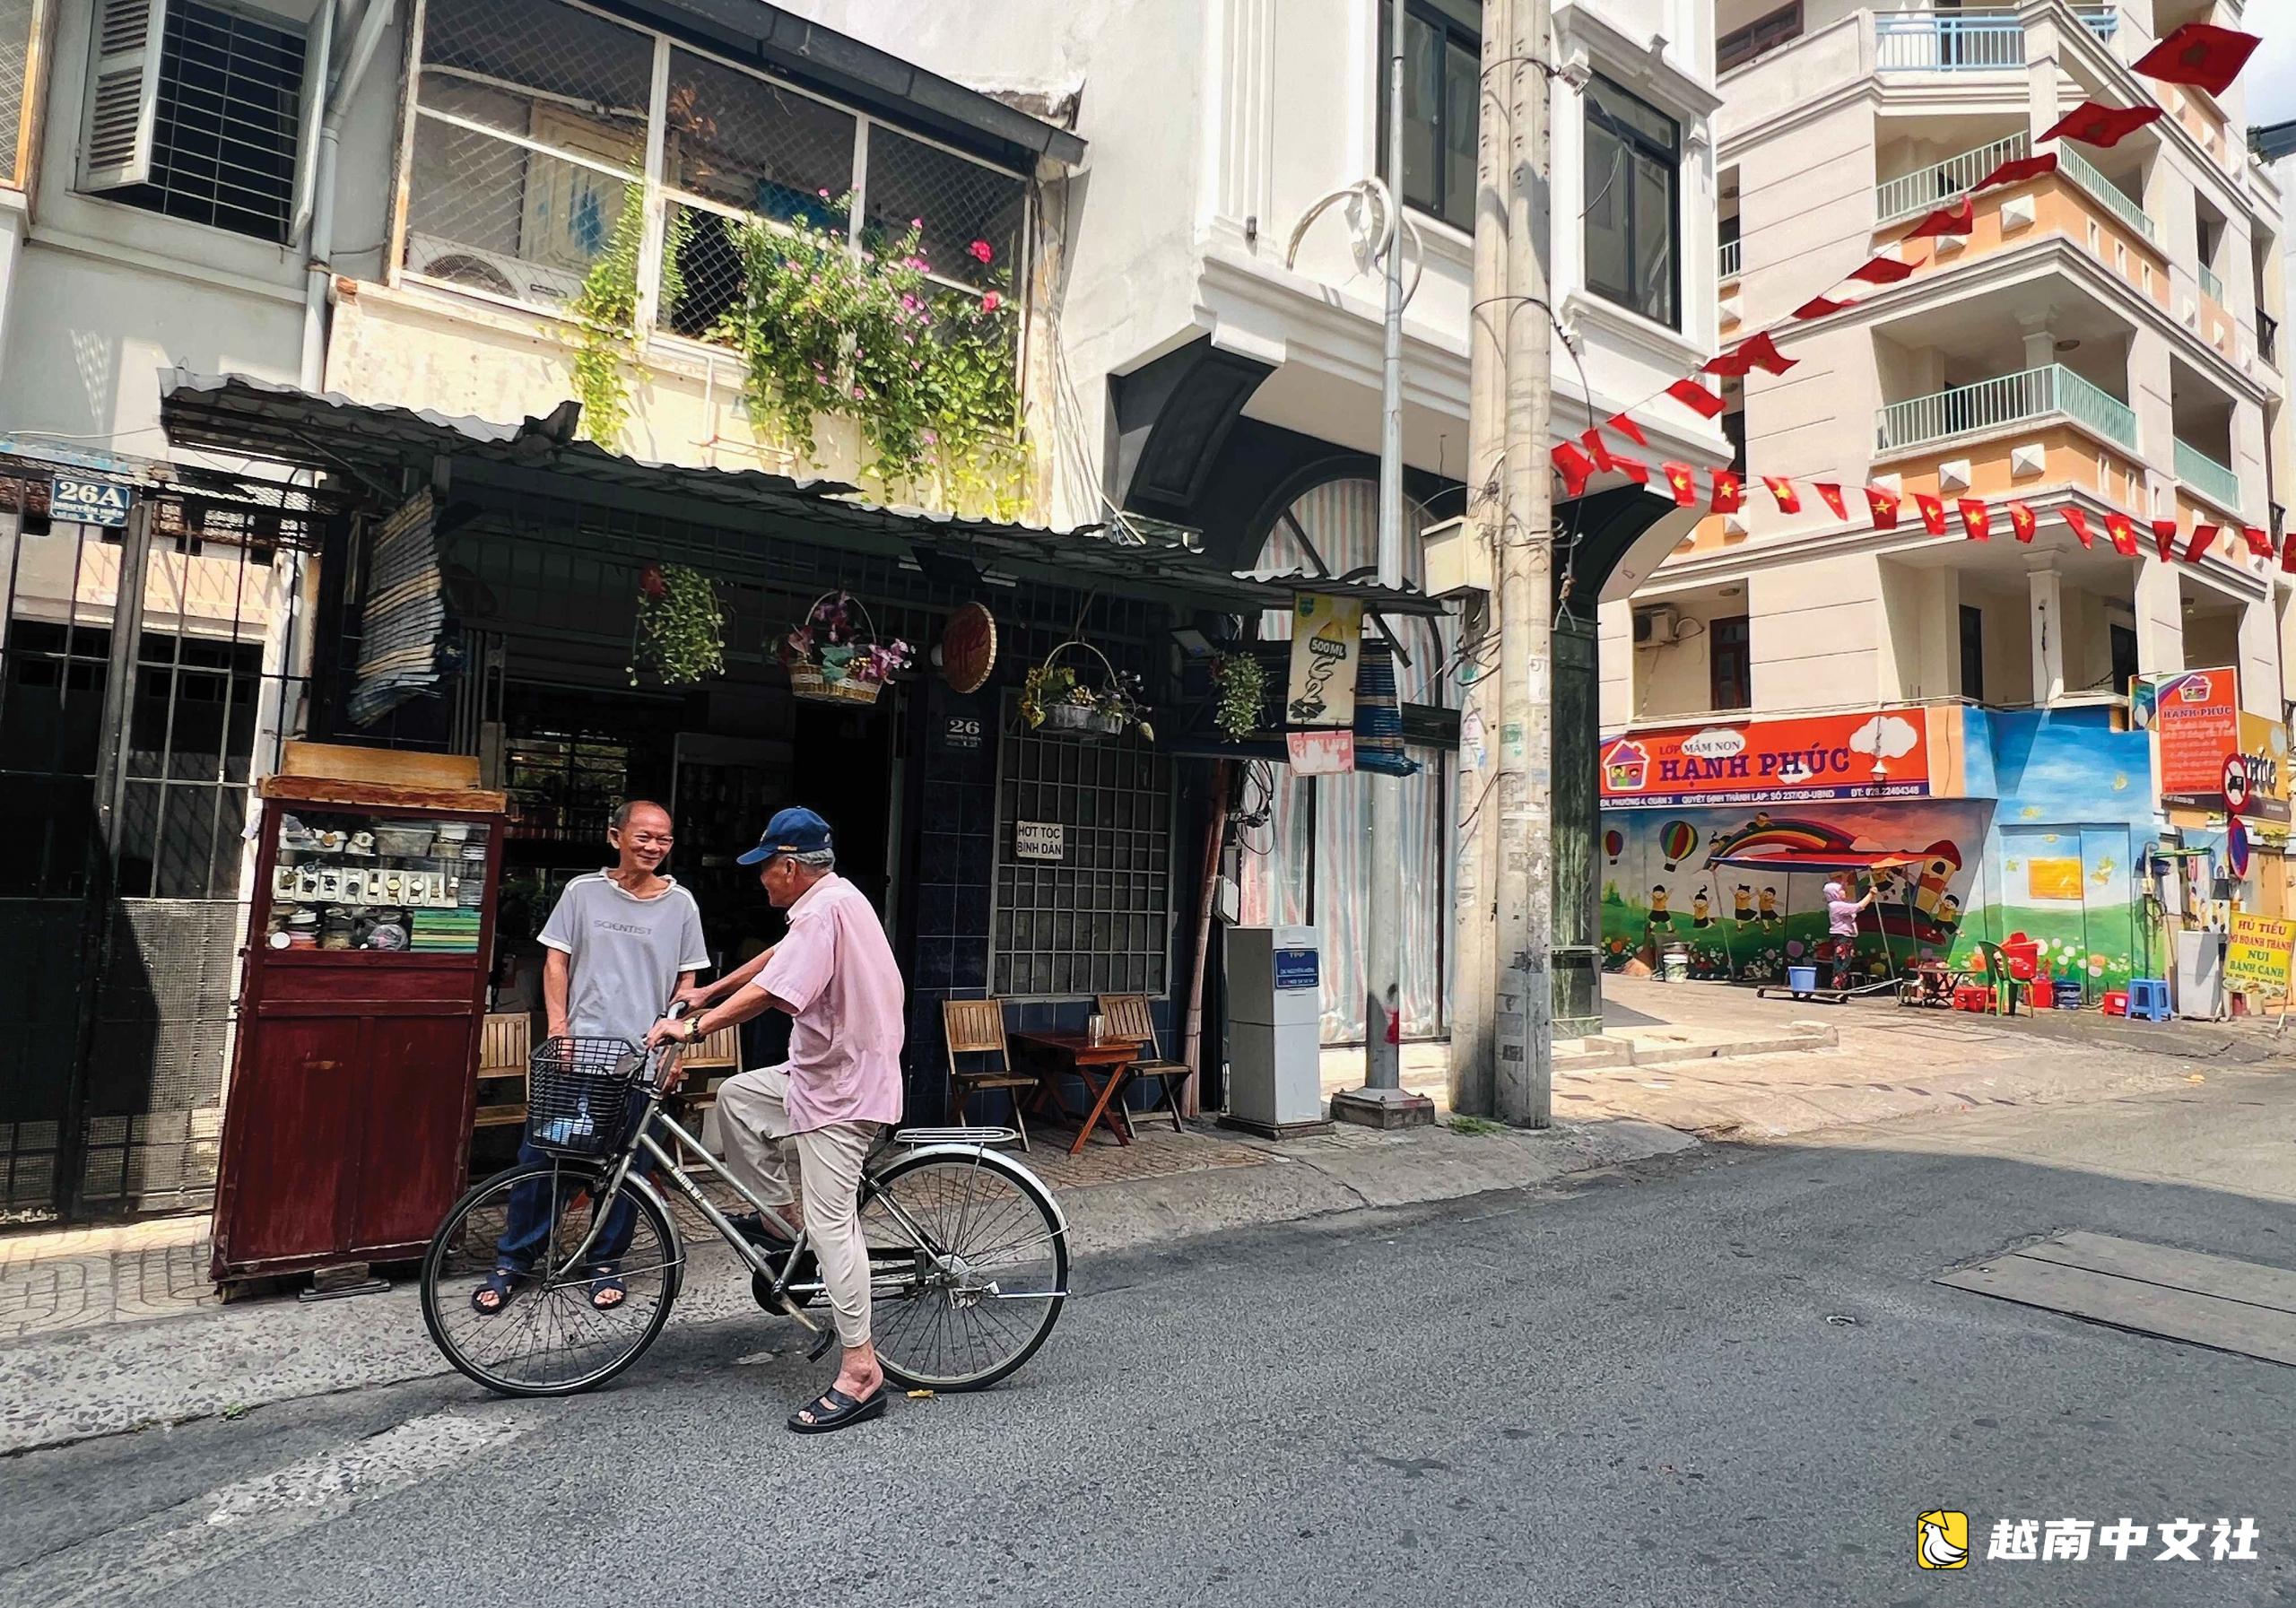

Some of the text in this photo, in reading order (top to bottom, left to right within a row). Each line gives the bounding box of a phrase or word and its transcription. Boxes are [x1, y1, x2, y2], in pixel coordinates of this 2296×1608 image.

[57, 481, 125, 508] 26A
[949, 719, 980, 734] 26
[1715, 740, 1741, 751] NON
[1659, 742, 1850, 787] HẠNH PHÚC
[593, 919, 653, 935] SCIENTIST
[2248, 950, 2270, 962] NUI
